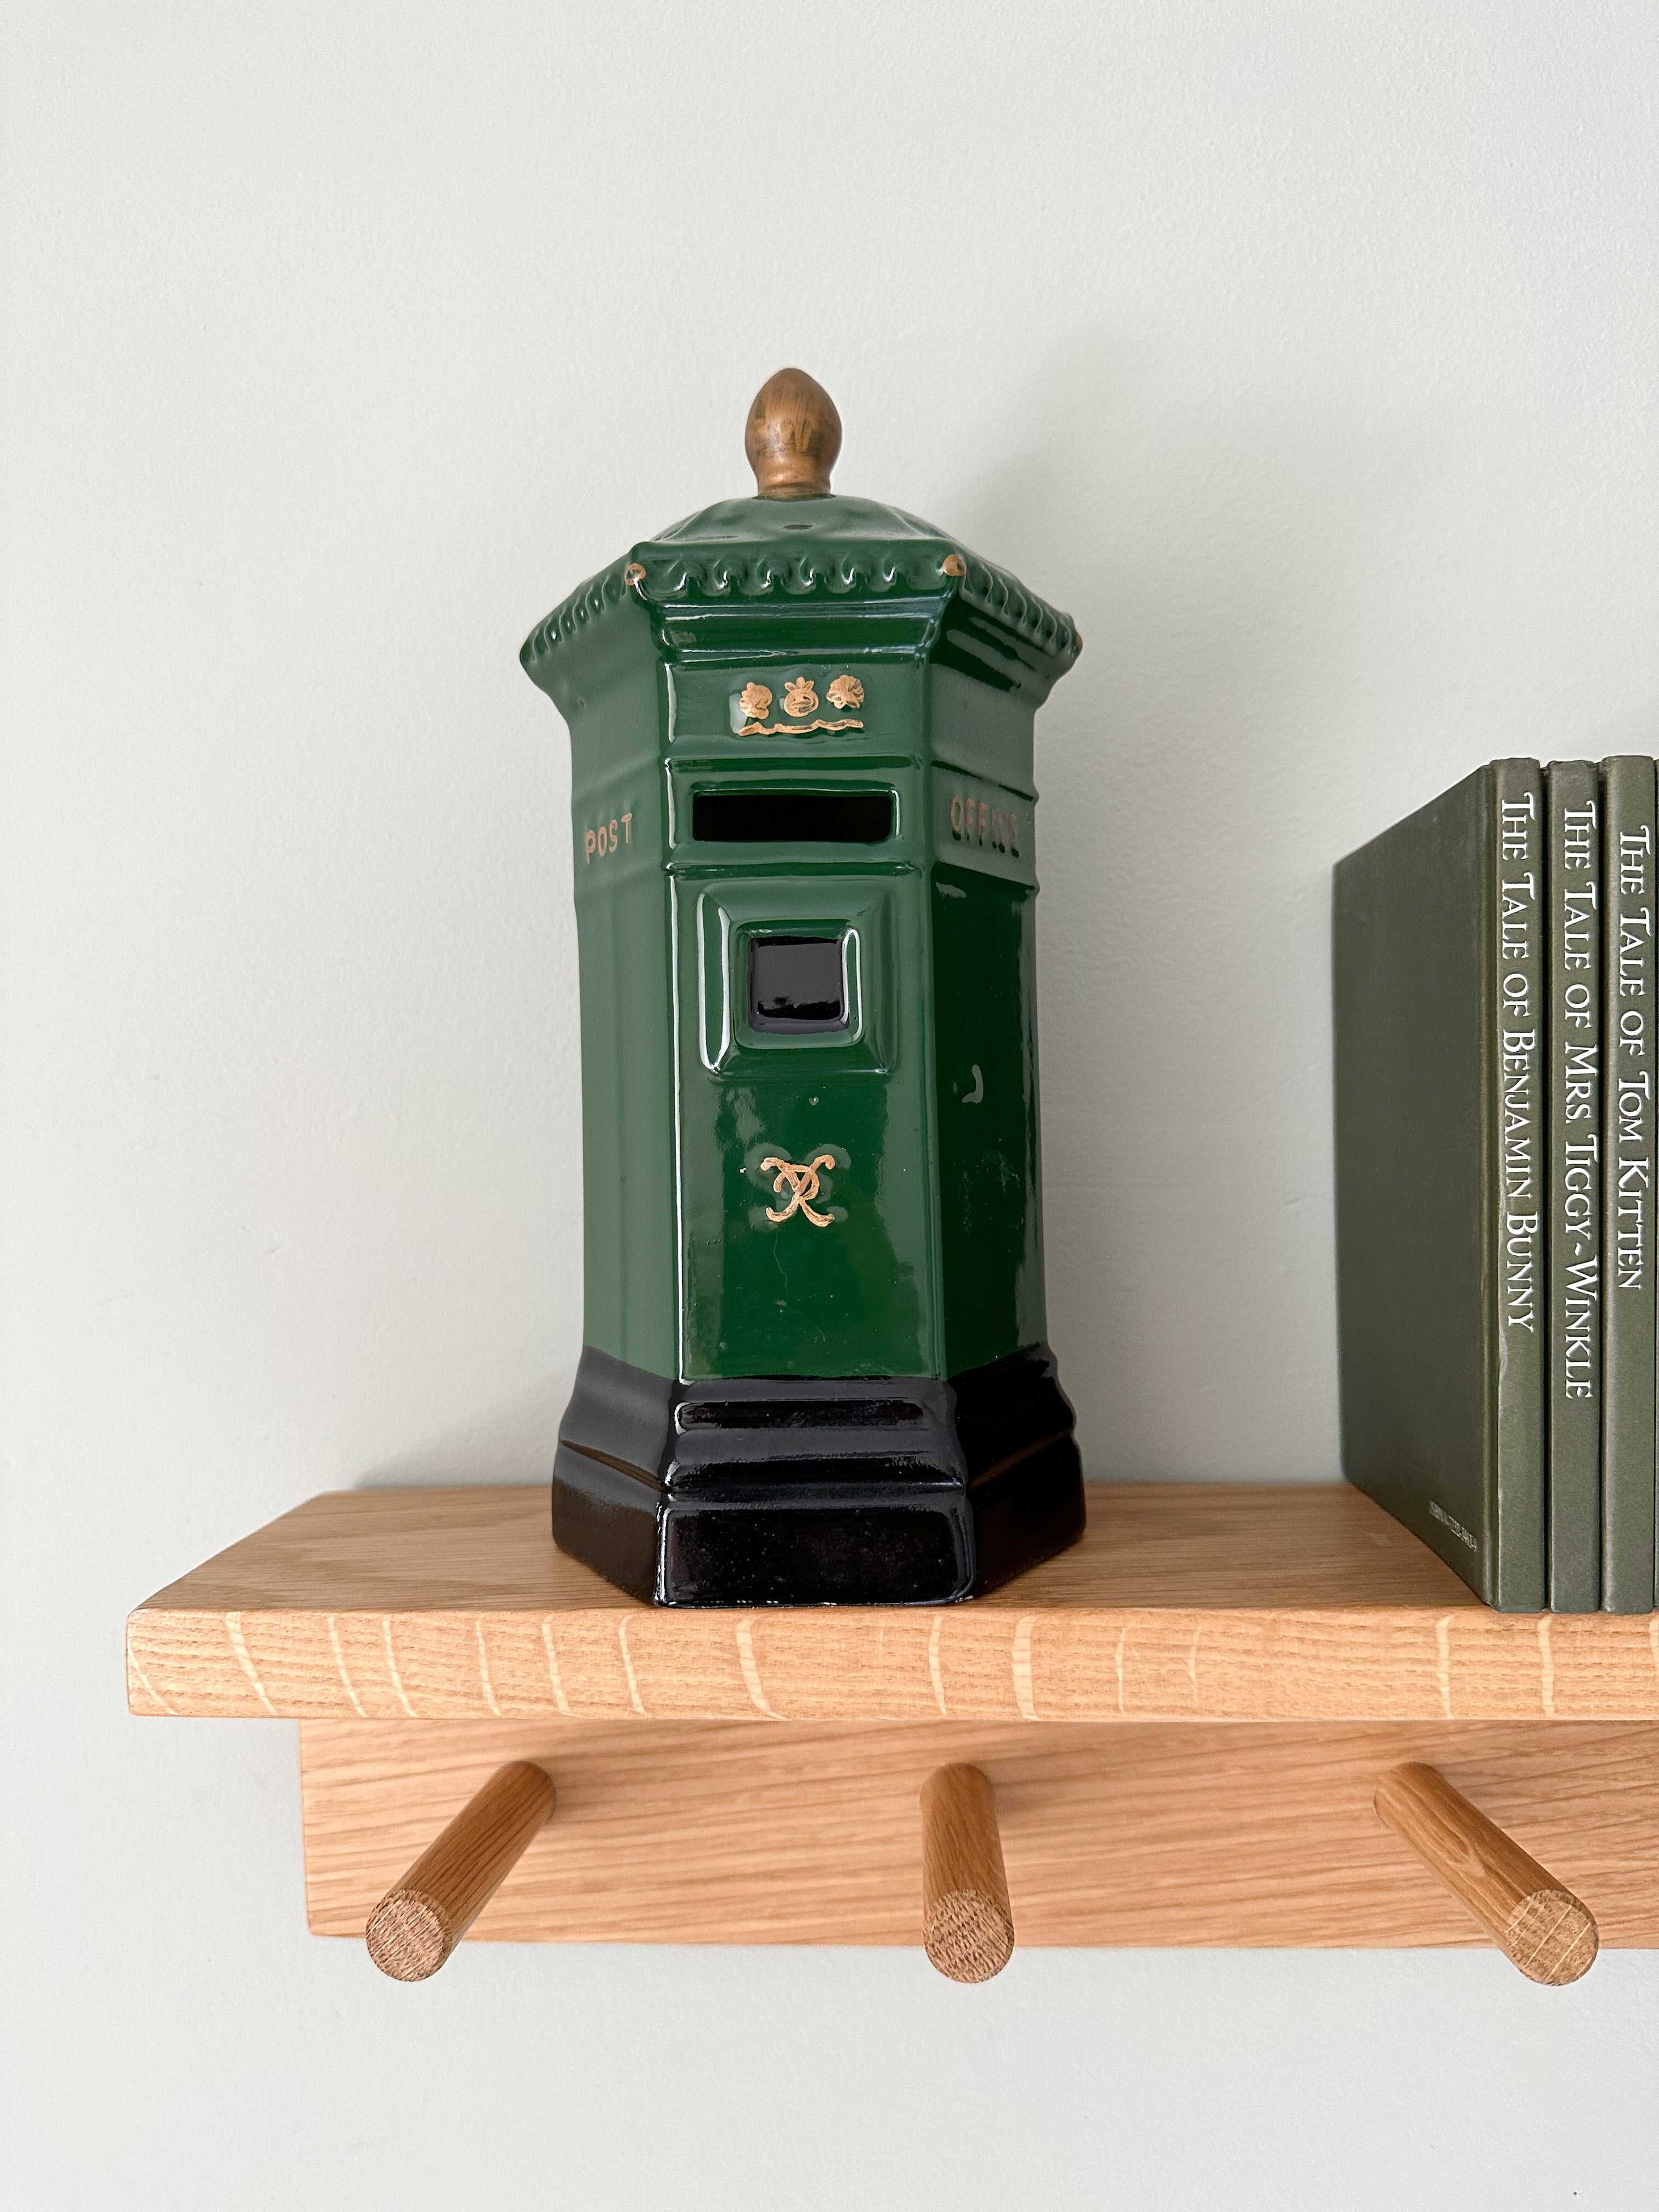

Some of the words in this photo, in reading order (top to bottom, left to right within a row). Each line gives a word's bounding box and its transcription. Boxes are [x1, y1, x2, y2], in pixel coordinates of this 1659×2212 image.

[585, 812, 632, 865] POST
[1502, 792, 1535, 860] THE
[1564, 800, 1596, 870] THE
[1620, 825, 1651, 894] THE
[1502, 872, 1535, 960] TALE
[1564, 882, 1596, 970] TALE
[1619, 907, 1651, 997] TALE
[1503, 973, 1530, 1017] OF
[1565, 984, 1592, 1028] OF
[1619, 1011, 1645, 1056] OF
[1503, 1029, 1536, 1199] BENJAMIN
[1565, 1041, 1597, 1124] MRS.
[1618, 1071, 1650, 1143] TOM
[1617, 1156, 1649, 1290] KITTEN
[1506, 1211, 1538, 1333] BUNNY
